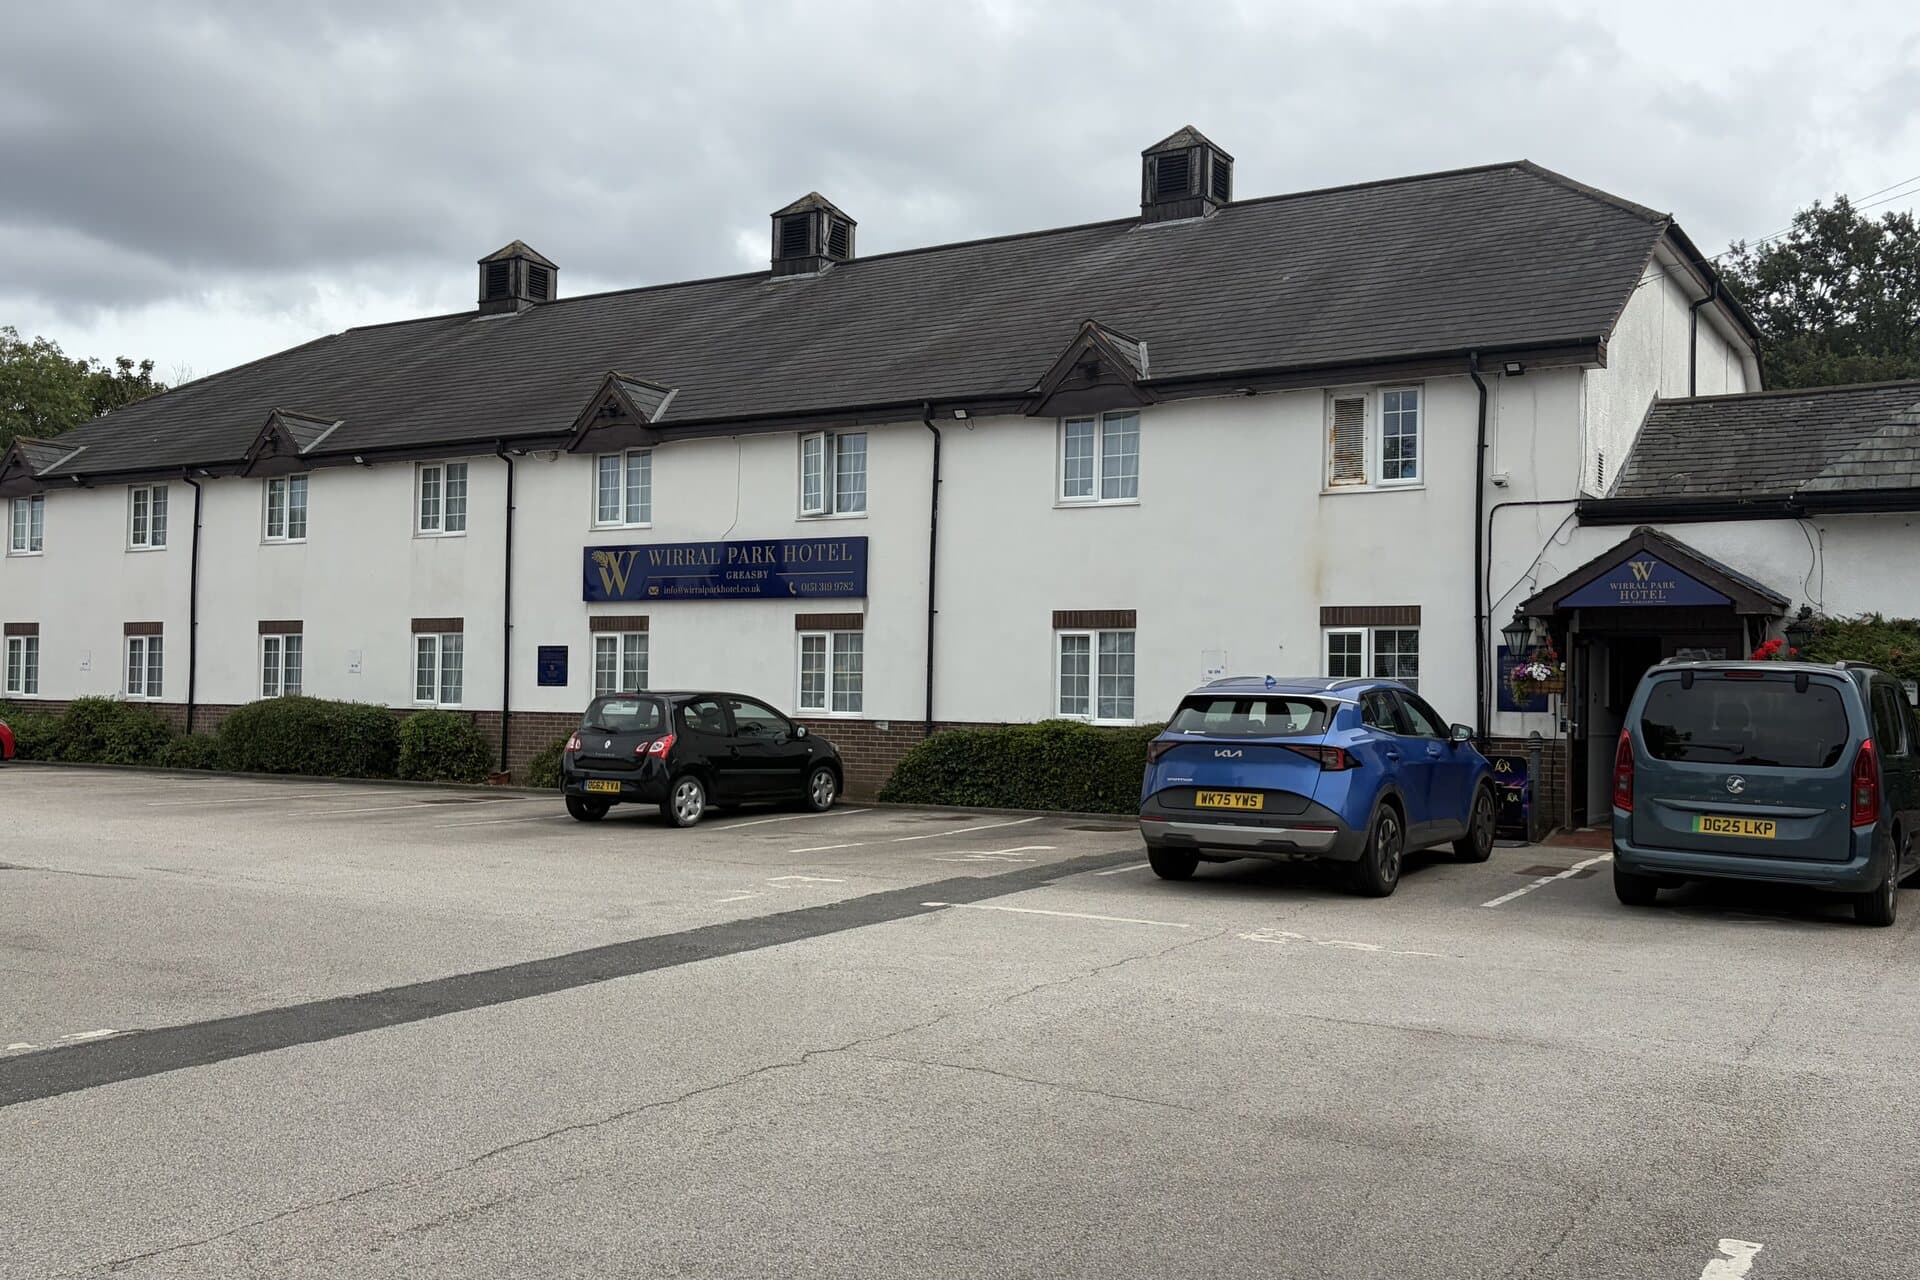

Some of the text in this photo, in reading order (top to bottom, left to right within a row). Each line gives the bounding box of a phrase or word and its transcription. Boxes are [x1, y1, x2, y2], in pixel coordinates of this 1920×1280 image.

[648, 543, 853, 567] WIRRAL PARK HOTEL
[592, 549, 640, 597] W
[725, 570, 769, 580] GREASBY
[663, 584, 761, 596] info@wirralparkhotel.co.uk
[1609, 581, 1676, 590] WIRRAL PARK
[1619, 590, 1667, 600] HOTEL
[1214, 749, 1243, 758] KIA
[1201, 792, 1258, 807] WK75 YWS
[1703, 818, 1774, 836] DG25 LKP
